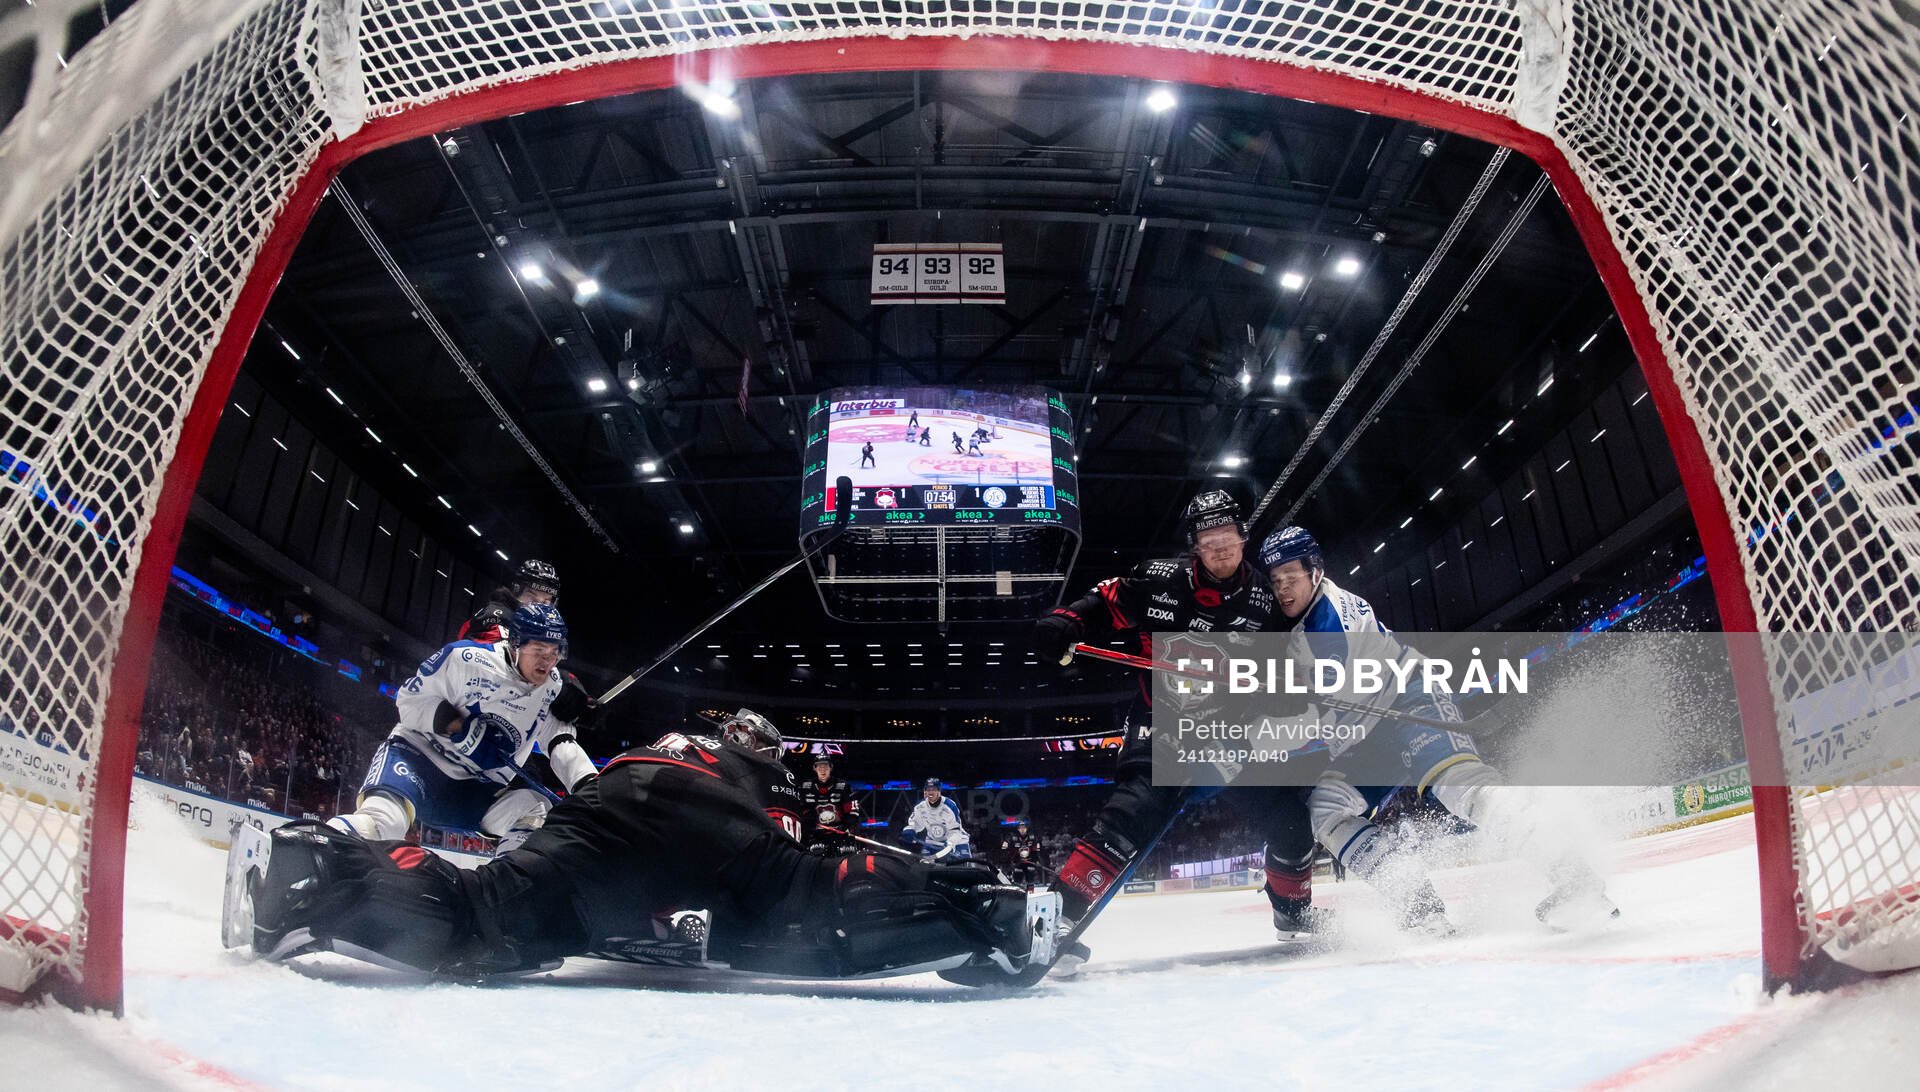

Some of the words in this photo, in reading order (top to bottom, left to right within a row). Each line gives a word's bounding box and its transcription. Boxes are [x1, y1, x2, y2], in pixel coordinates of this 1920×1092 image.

[880, 258, 909, 275] 94
[924, 258, 951, 274] 93
[968, 258, 995, 274] 92
[836, 400, 897, 411] Interbus
[926, 491, 954, 502] 07:54
[886, 511, 913, 519] akea
[955, 510, 982, 519] akea
[1024, 510, 1051, 519] akea
[1196, 515, 1233, 530] BJURFORS
[1147, 607, 1175, 622] DOXA
[1409, 732, 1428, 748] Clas
[1411, 733, 1442, 756] Ohlson
